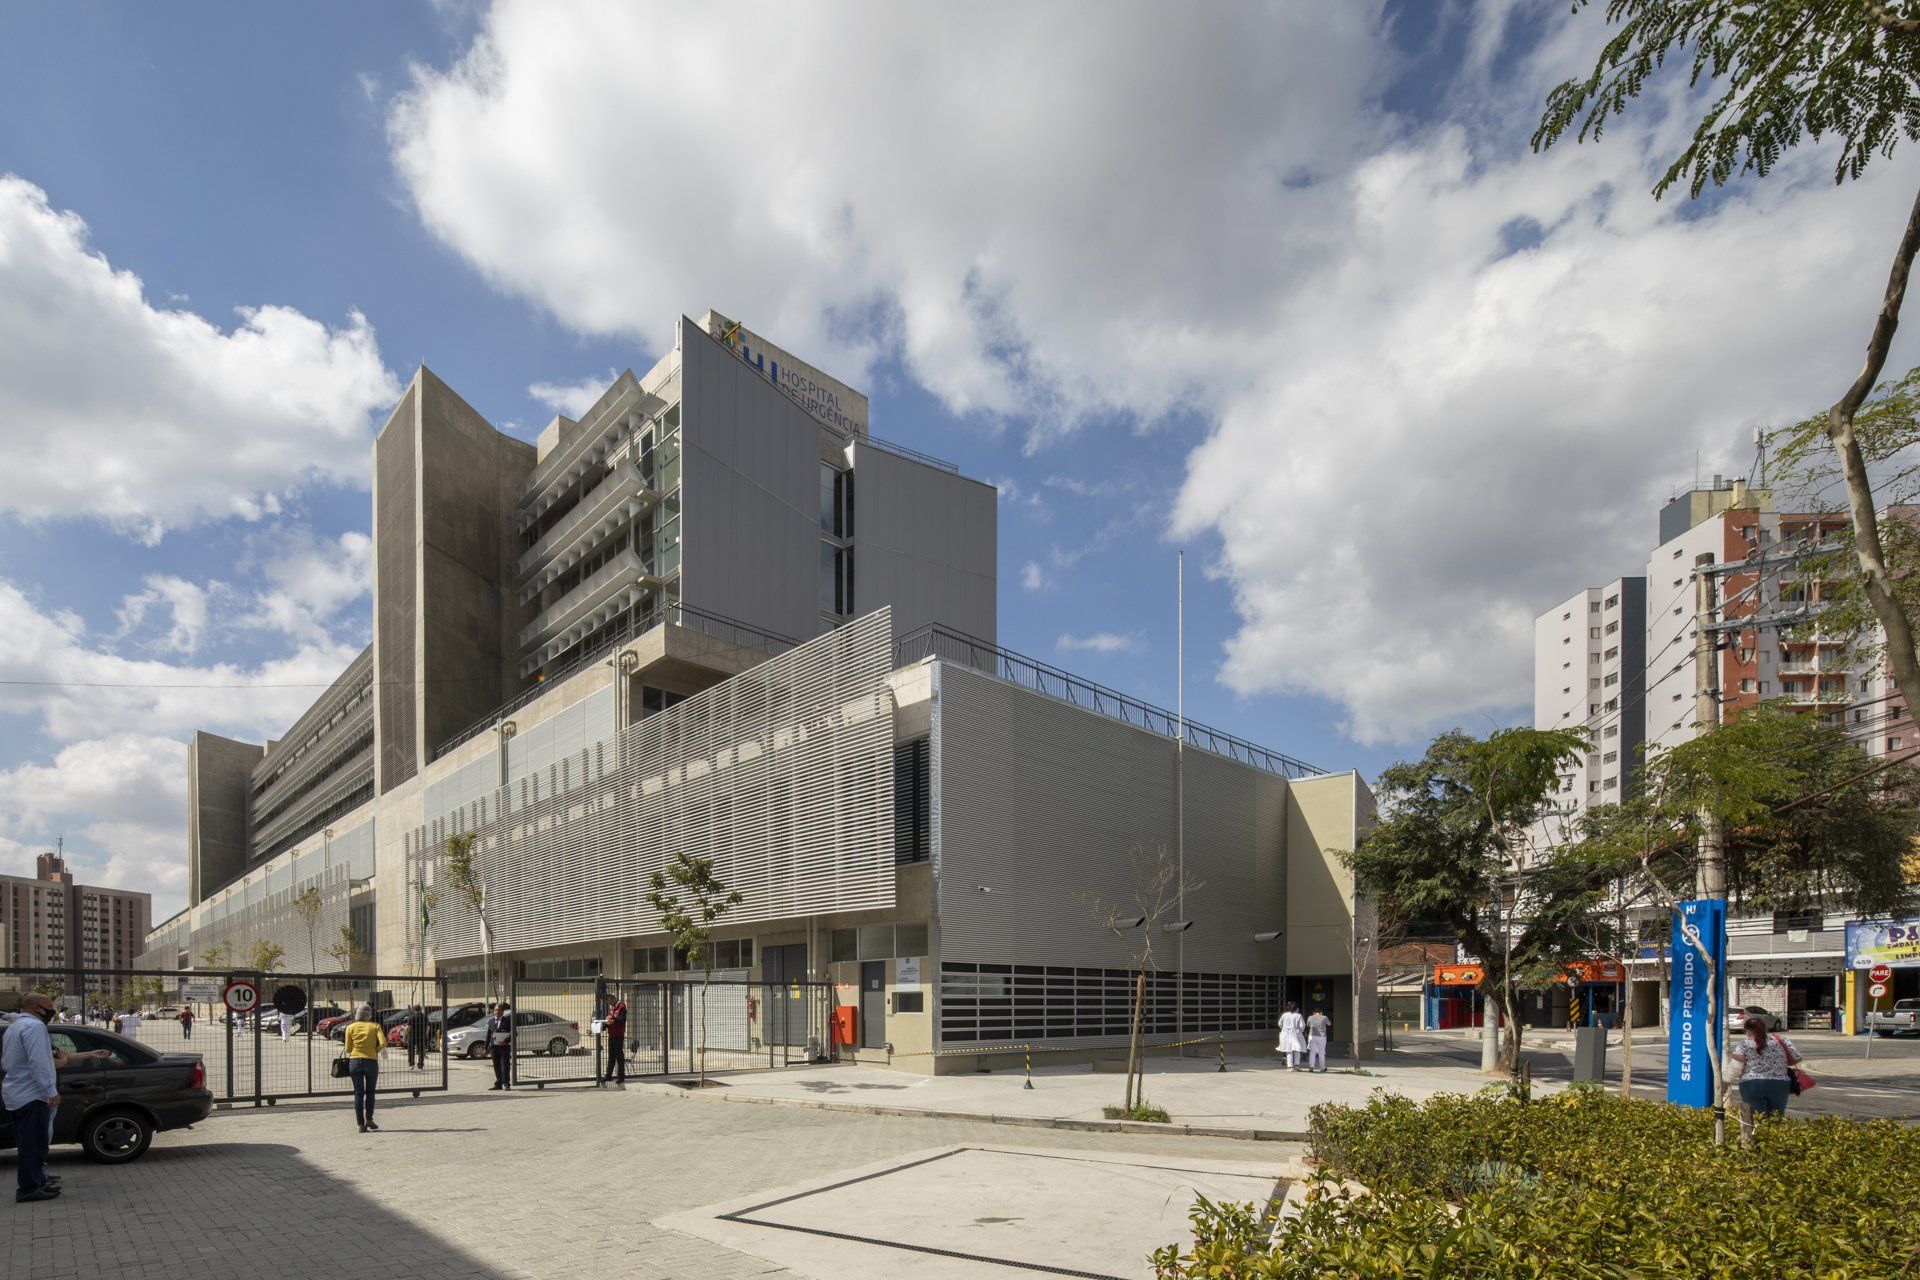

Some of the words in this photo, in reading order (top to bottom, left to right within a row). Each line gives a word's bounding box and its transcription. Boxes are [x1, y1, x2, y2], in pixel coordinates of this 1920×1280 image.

[782, 367, 842, 412] HOSPITAL
[802, 394, 860, 435] URGÊNCIA
[234, 989, 253, 1002] 10
[1683, 952, 1694, 1018] PROIBIDO
[1681, 1022, 1692, 1081] SENTIDO
